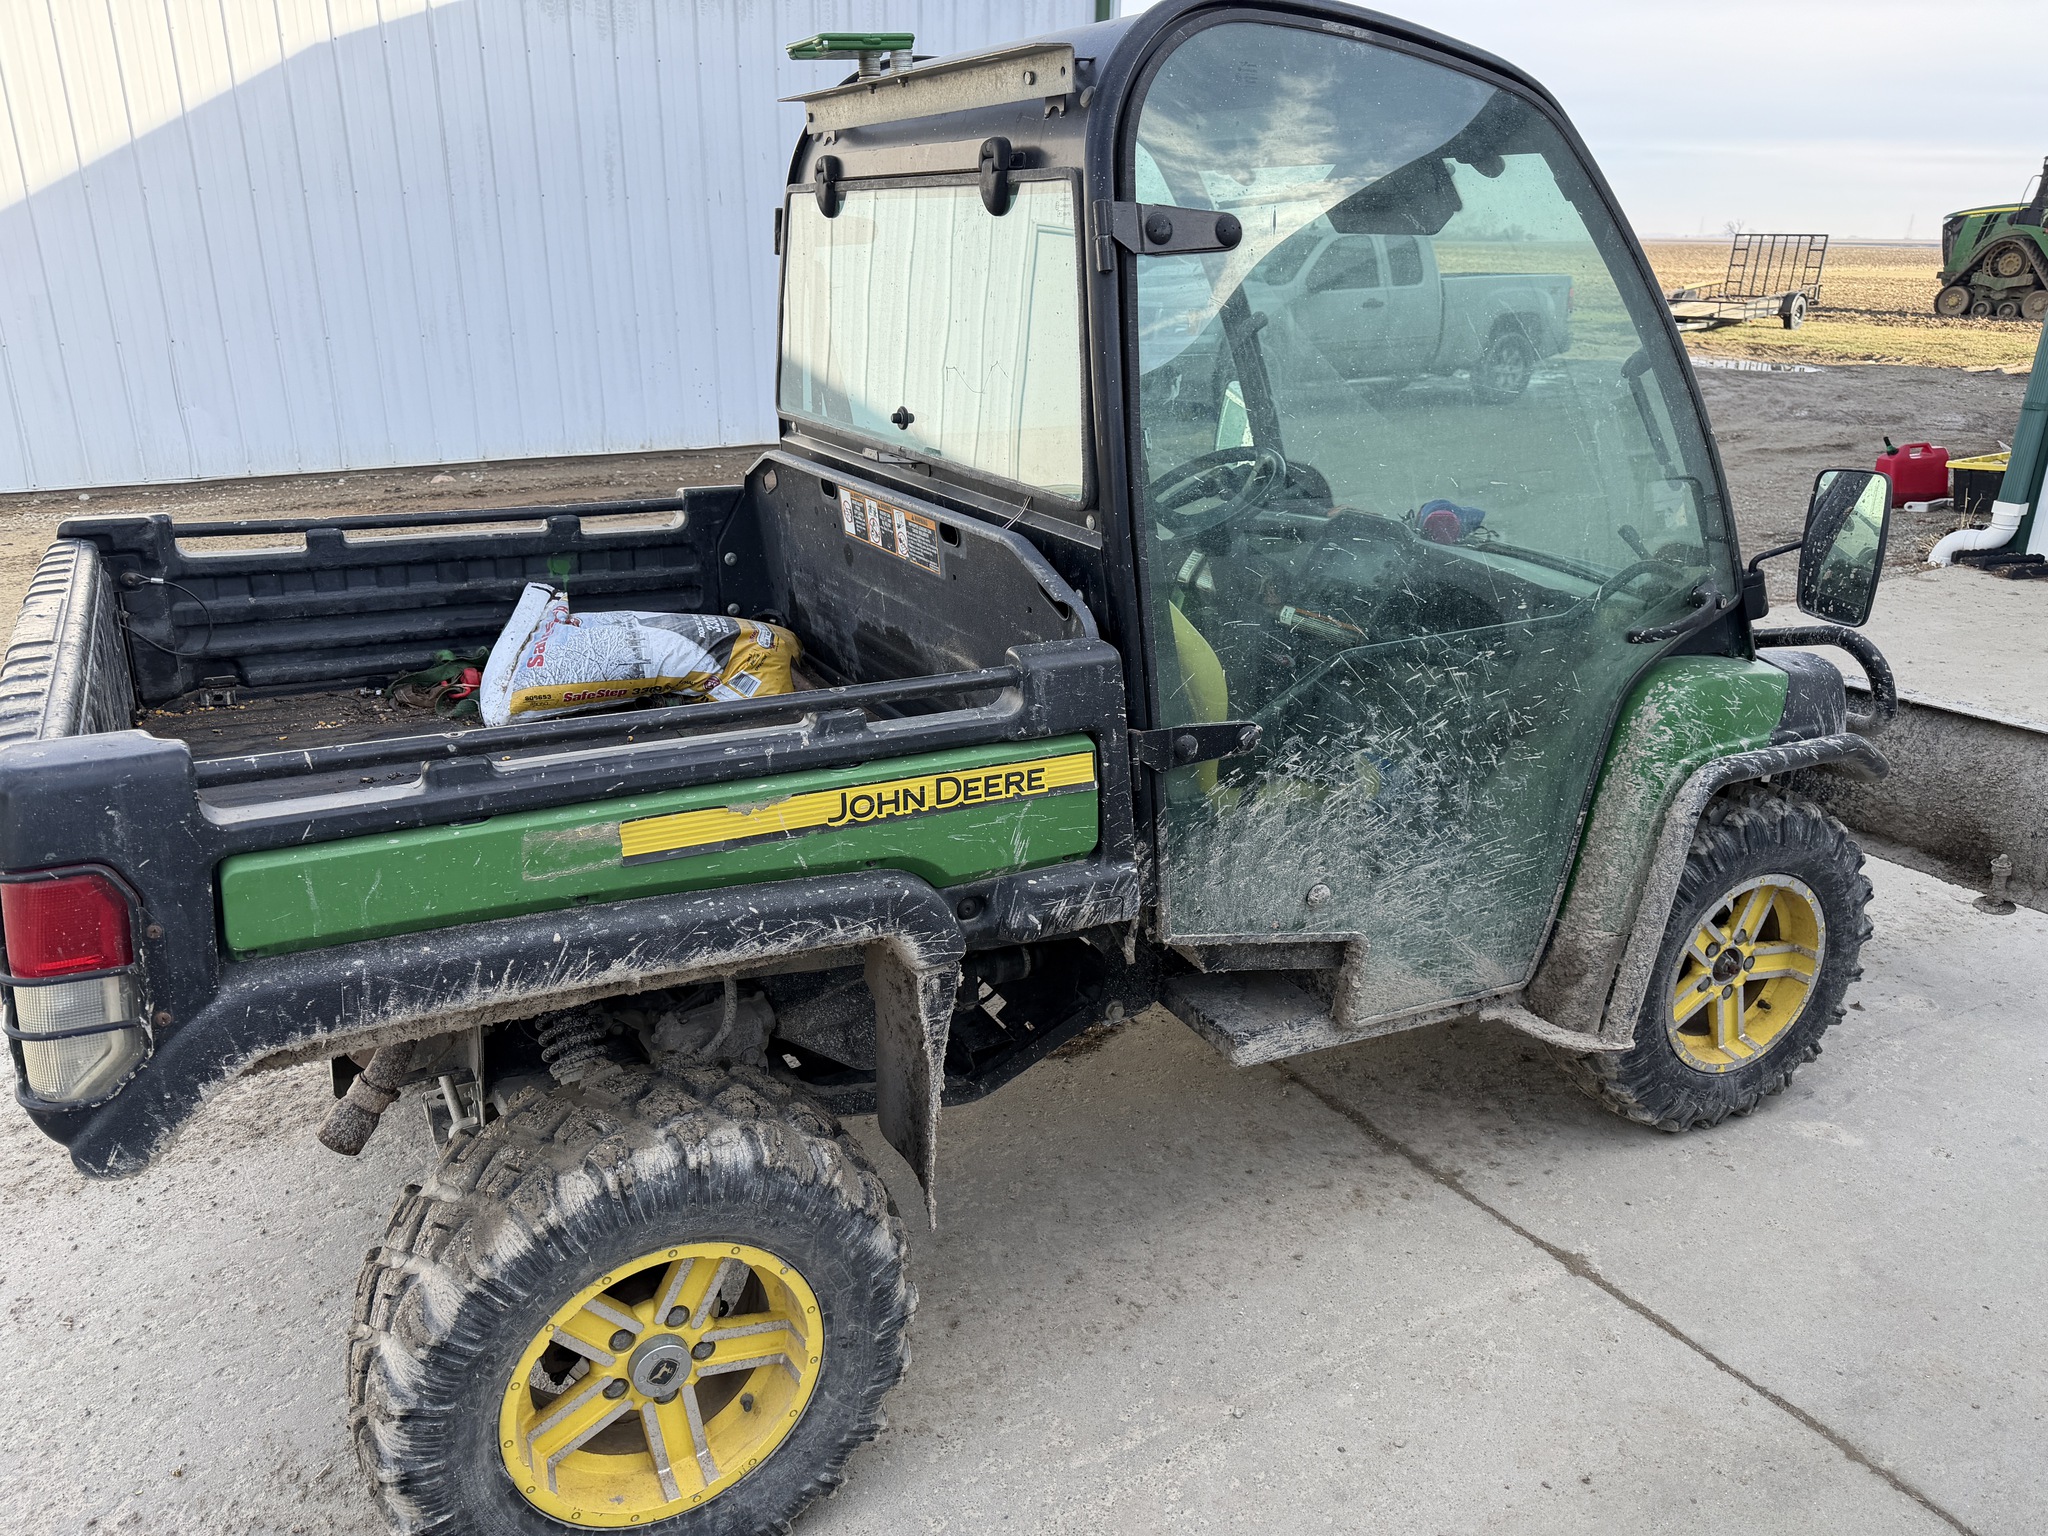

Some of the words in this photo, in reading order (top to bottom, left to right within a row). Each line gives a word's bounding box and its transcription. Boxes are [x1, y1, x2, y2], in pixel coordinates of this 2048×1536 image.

[563, 688, 628, 703] SafeStep
[828, 786, 925, 823] JOHN
[936, 767, 1045, 804] DEERE
